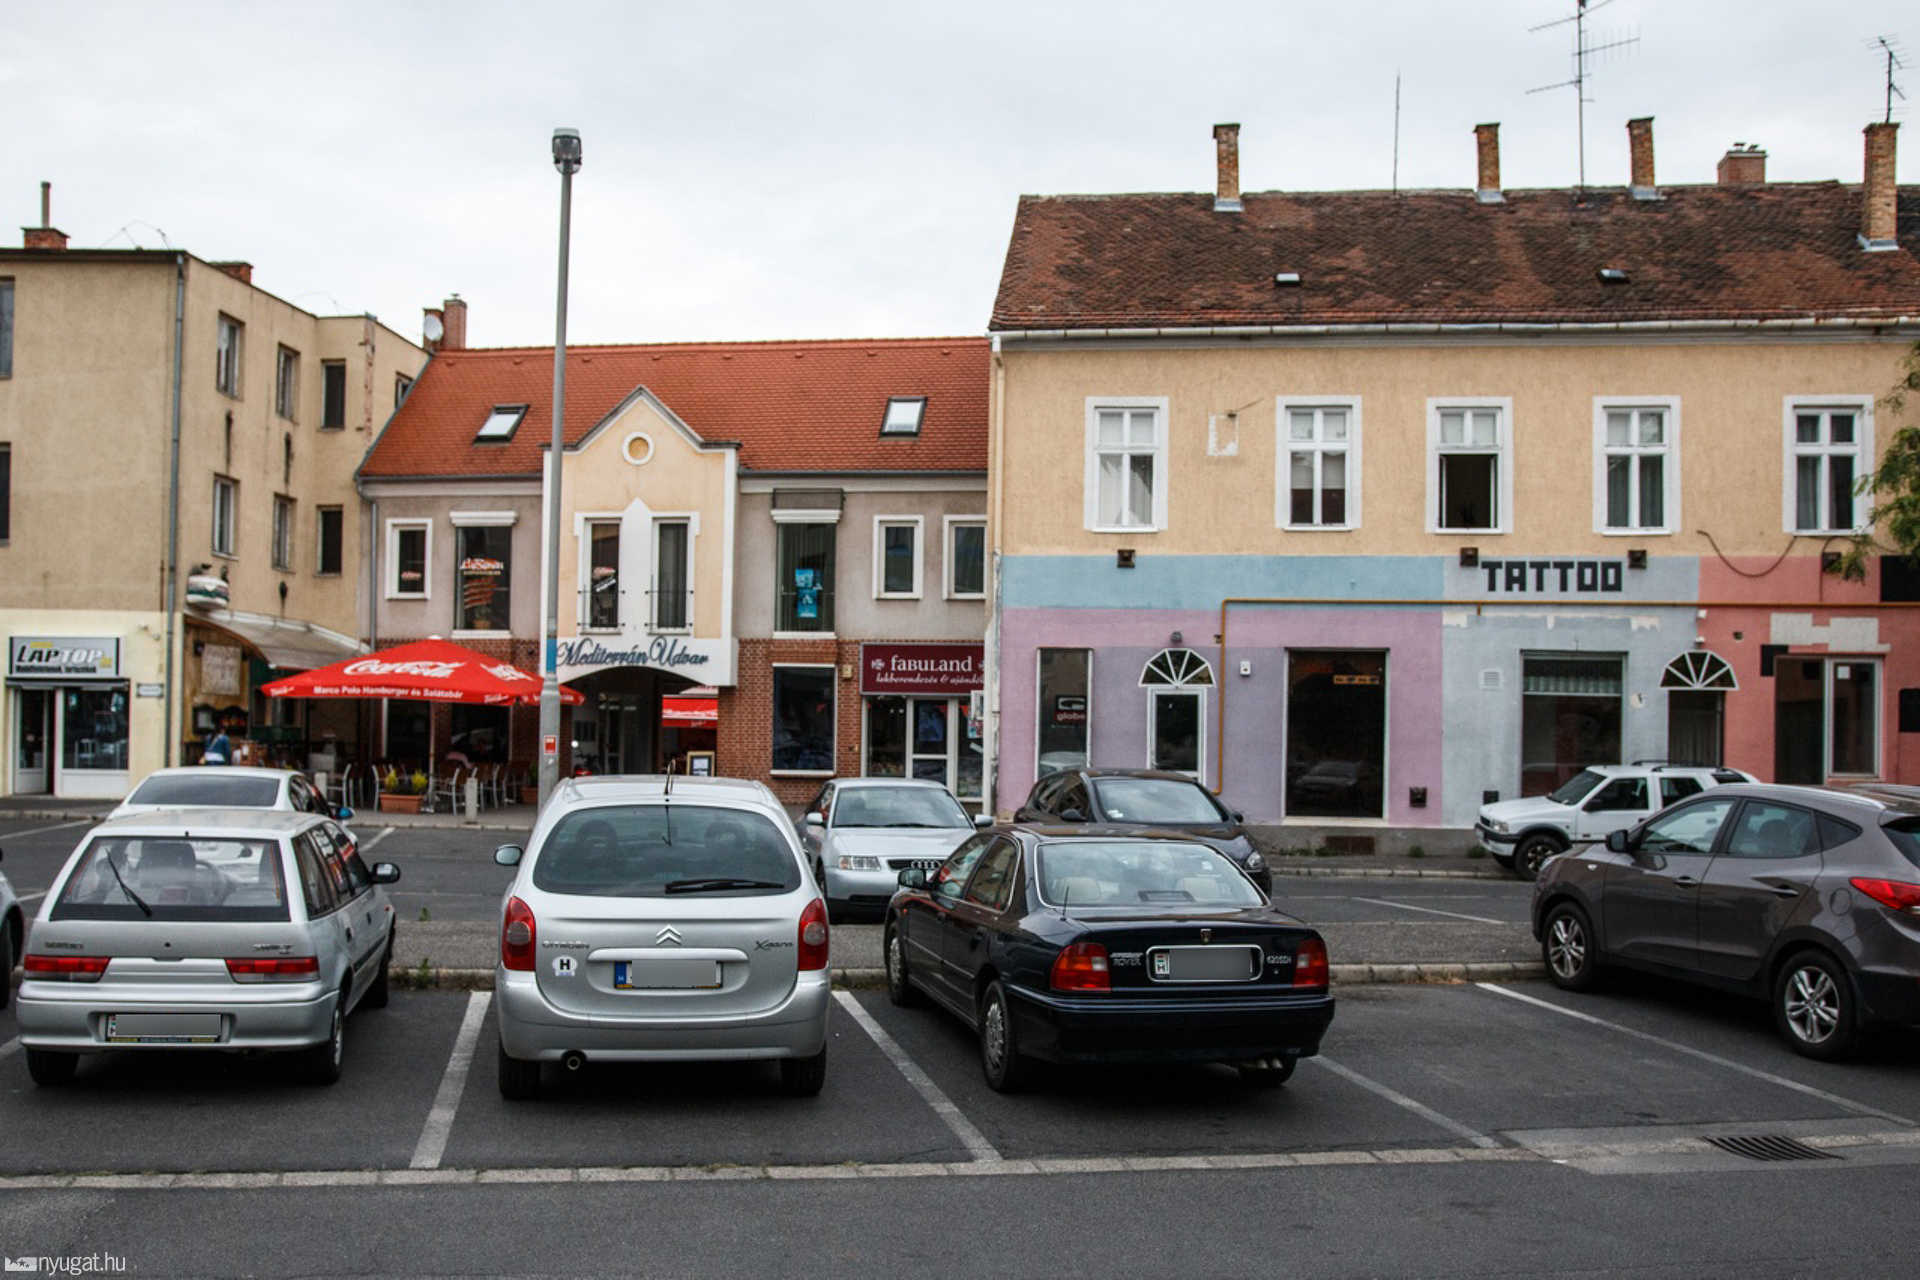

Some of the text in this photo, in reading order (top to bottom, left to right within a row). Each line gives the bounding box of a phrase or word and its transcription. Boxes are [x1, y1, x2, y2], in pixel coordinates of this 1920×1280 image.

[1481, 561, 1622, 592] TATTOO
[17, 645, 102, 663] LAPTOP
[556, 635, 709, 667] Mediterrán Udvar
[313, 686, 340, 695] Marco
[341, 686, 361, 695] Polo
[362, 686, 409, 697] Hamburger
[559, 958, 571, 971] H
